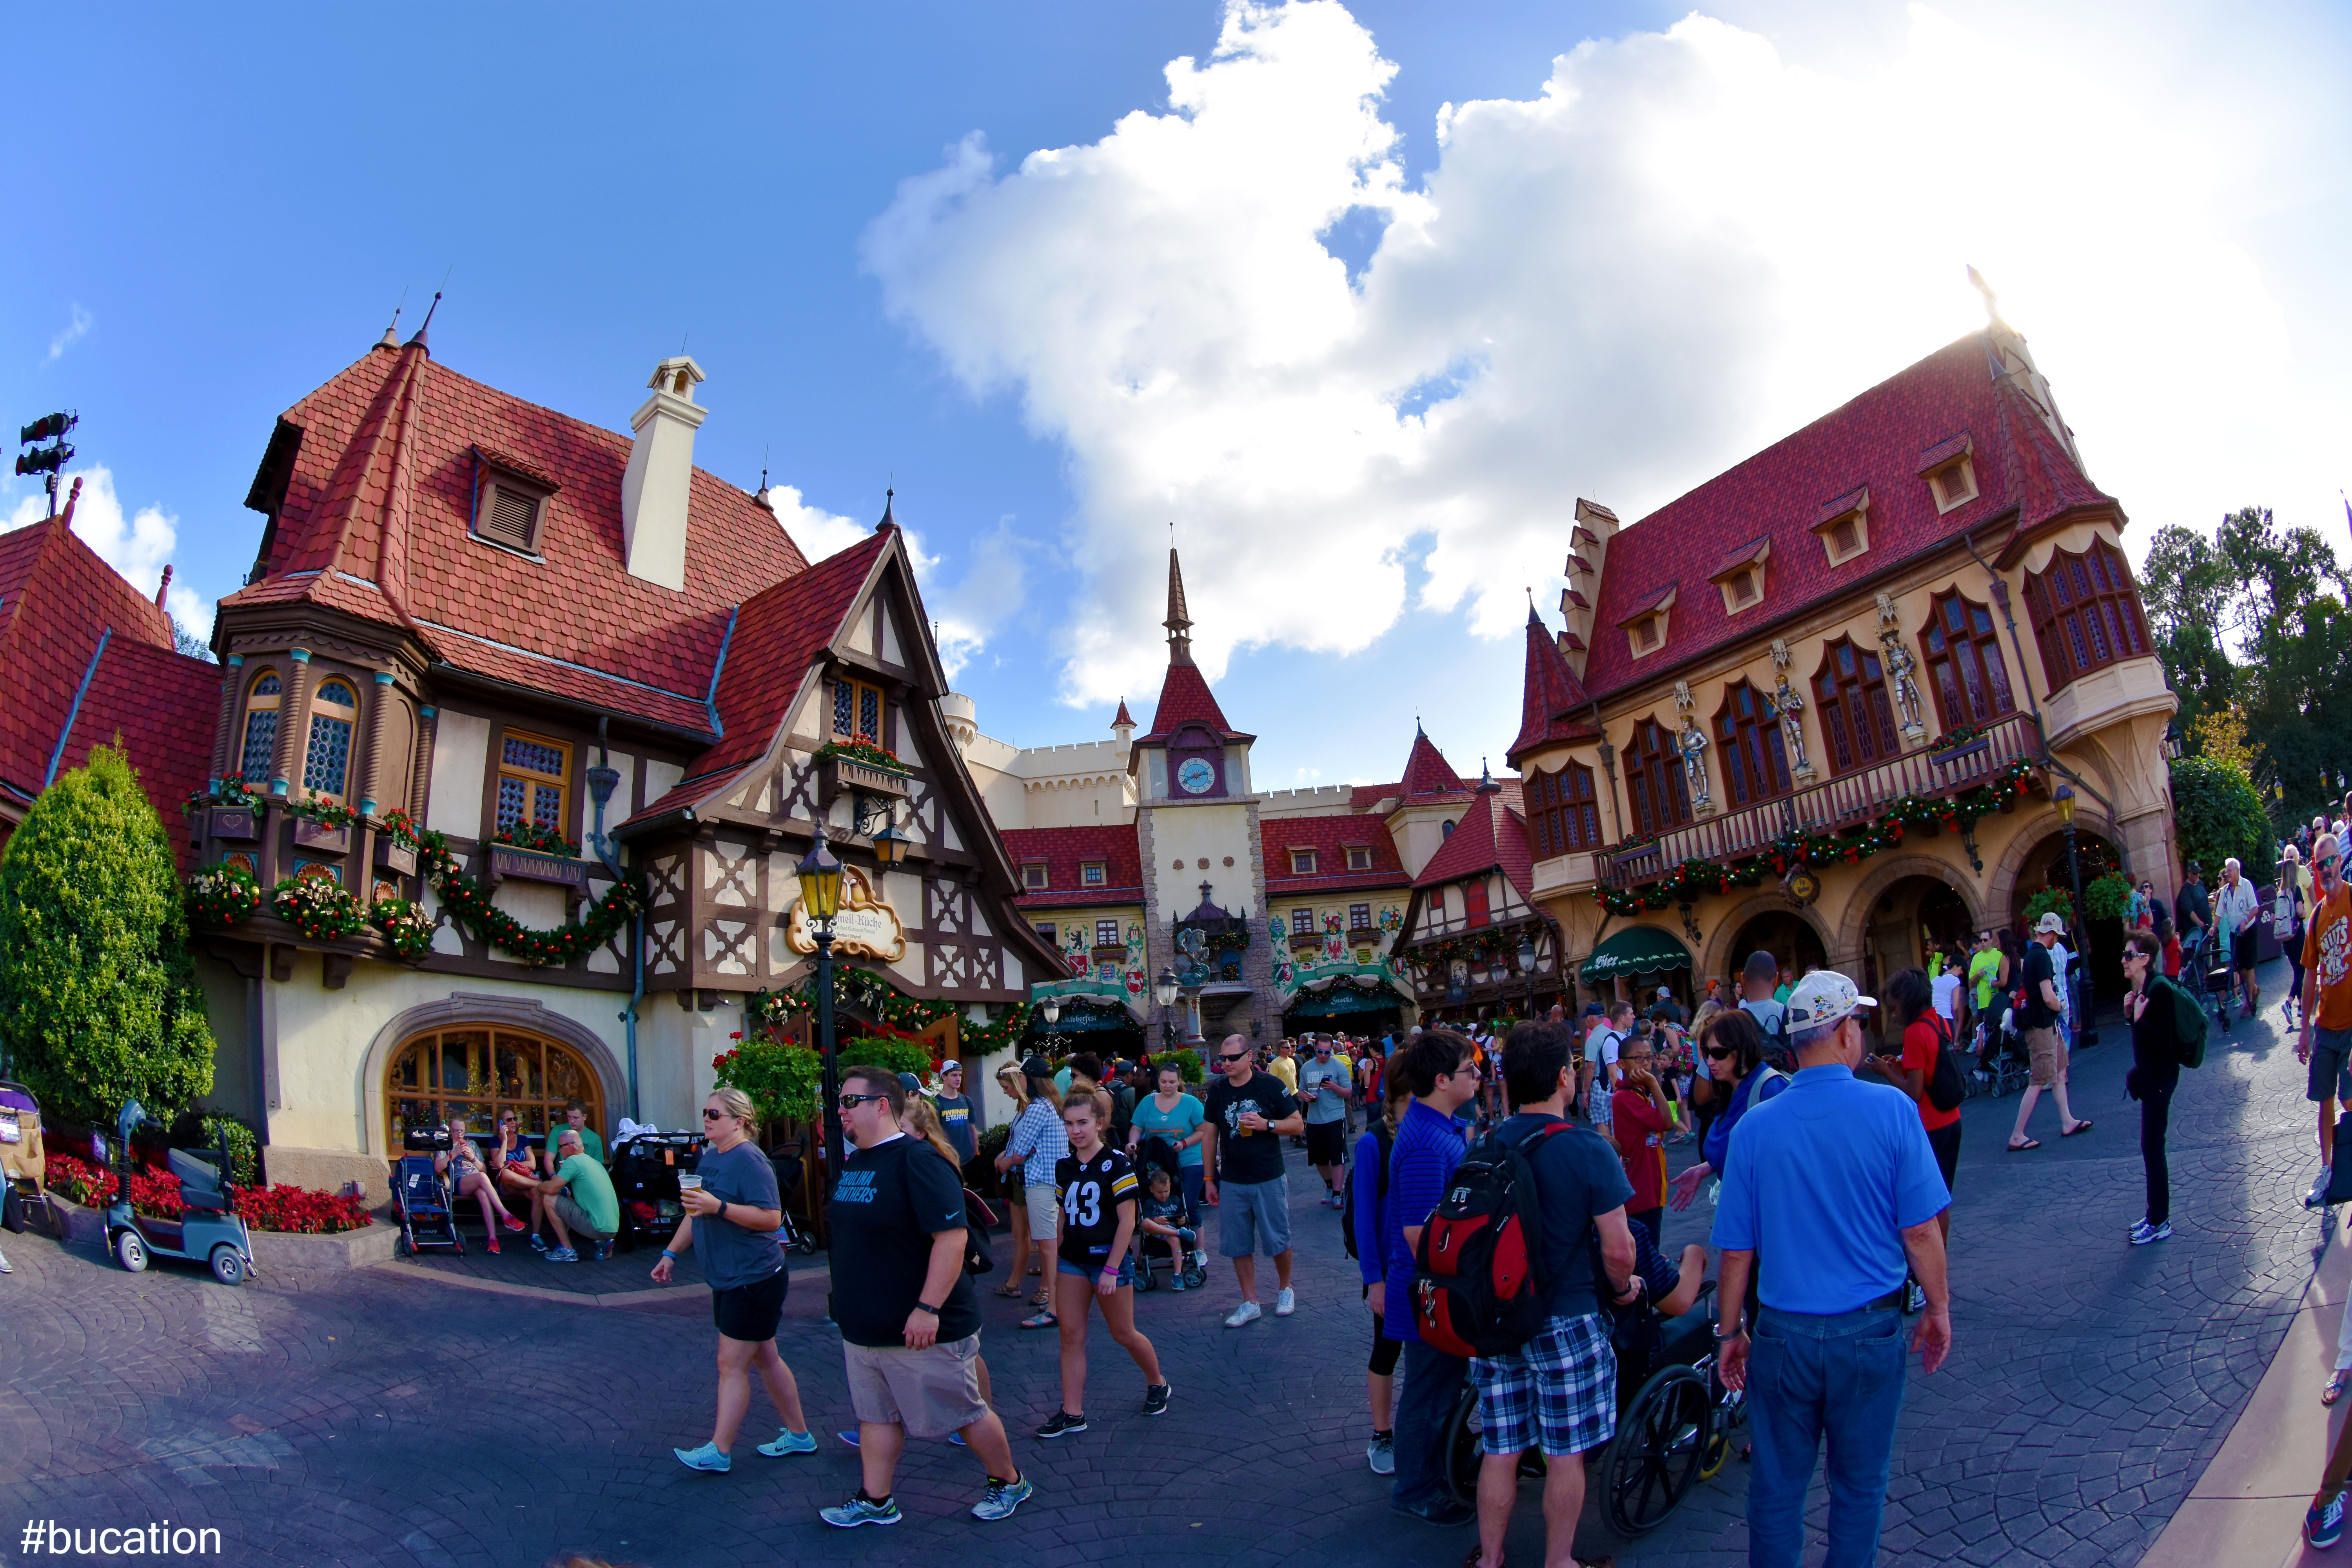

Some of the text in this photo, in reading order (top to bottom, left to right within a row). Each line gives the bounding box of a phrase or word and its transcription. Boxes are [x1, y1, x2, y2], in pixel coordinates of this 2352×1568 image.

[838, 913, 882, 930] mell-Küche
[2320, 924, 2348, 953] NUTS
[1594, 953, 1618, 969] Bier
[1331, 995, 1353, 1005] Snacks
[838, 1171, 876, 1186] CAROLINA
[833, 1186, 877, 1203] PANTHERS
[1064, 1181, 1100, 1226] 43
